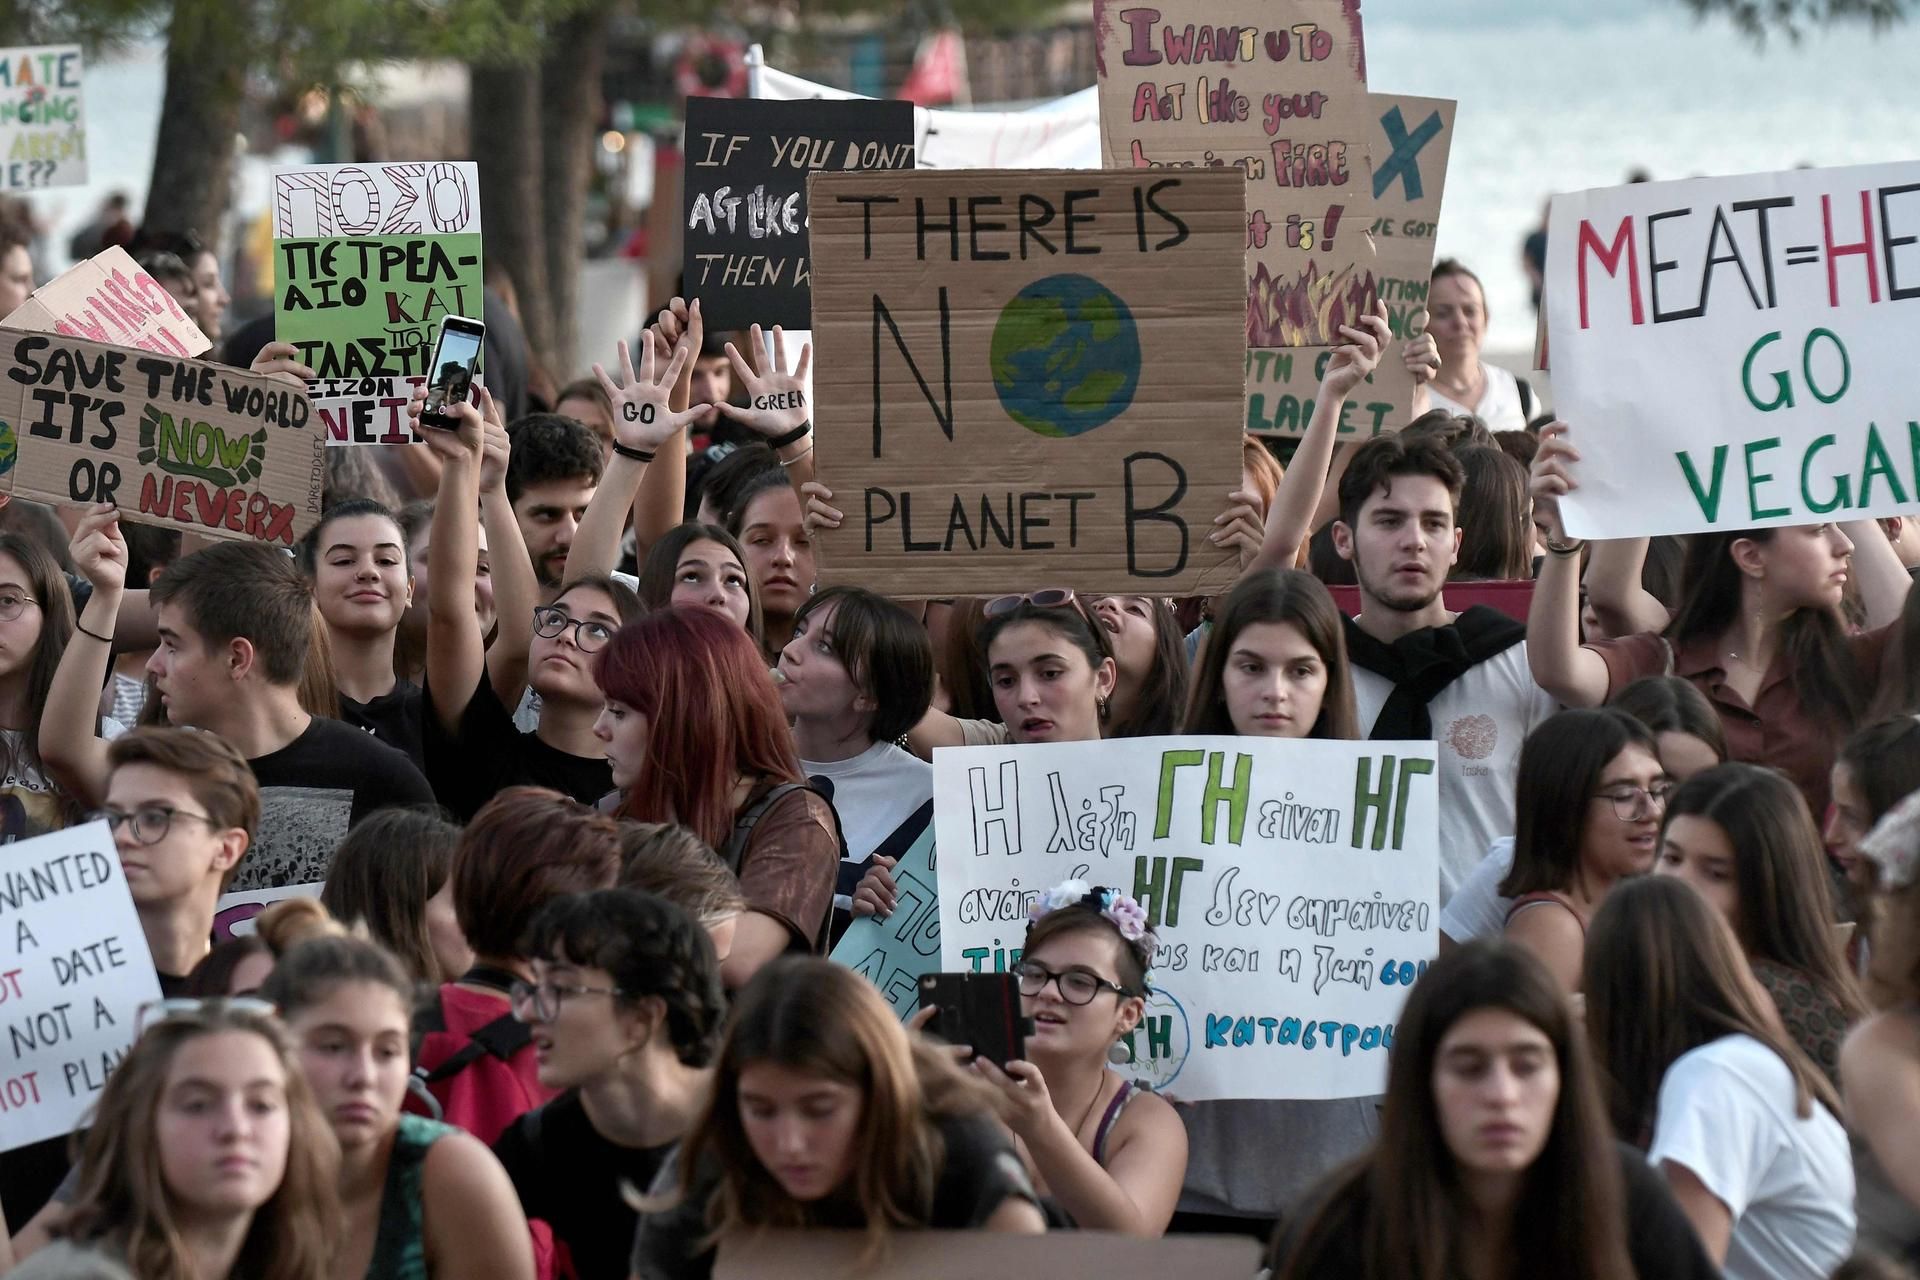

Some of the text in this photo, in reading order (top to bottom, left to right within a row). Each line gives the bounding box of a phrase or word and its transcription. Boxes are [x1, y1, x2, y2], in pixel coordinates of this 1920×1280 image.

[1163, 24, 1259, 65] WANT
[1263, 91, 1328, 136] your
[696, 133, 914, 169] IF YOU DONT
[276, 162, 470, 238] ΠΟΣΟ
[836, 178, 1190, 262] THERE IS
[1403, 219, 1436, 237] GOT
[284, 277, 367, 311] ΑΙΟ
[696, 254, 786, 287] THEN
[8, 337, 127, 392] SAVE
[137, 357, 217, 406] THE
[222, 379, 310, 429] WORLD
[1742, 327, 1851, 412] GO
[30, 388, 126, 450] IT'S
[623, 401, 655, 424] GO
[159, 413, 250, 471] NOW
[69, 458, 121, 507] OR
[864, 451, 1188, 578] PLANET B
[968, 760, 1022, 857] Η
[1153, 749, 1253, 847] ΓΗ
[1352, 755, 1436, 850] ΗΓ
[16, 920, 39, 953] A
[52, 937, 126, 987] DATE
[10, 998, 116, 1058] NOT A
